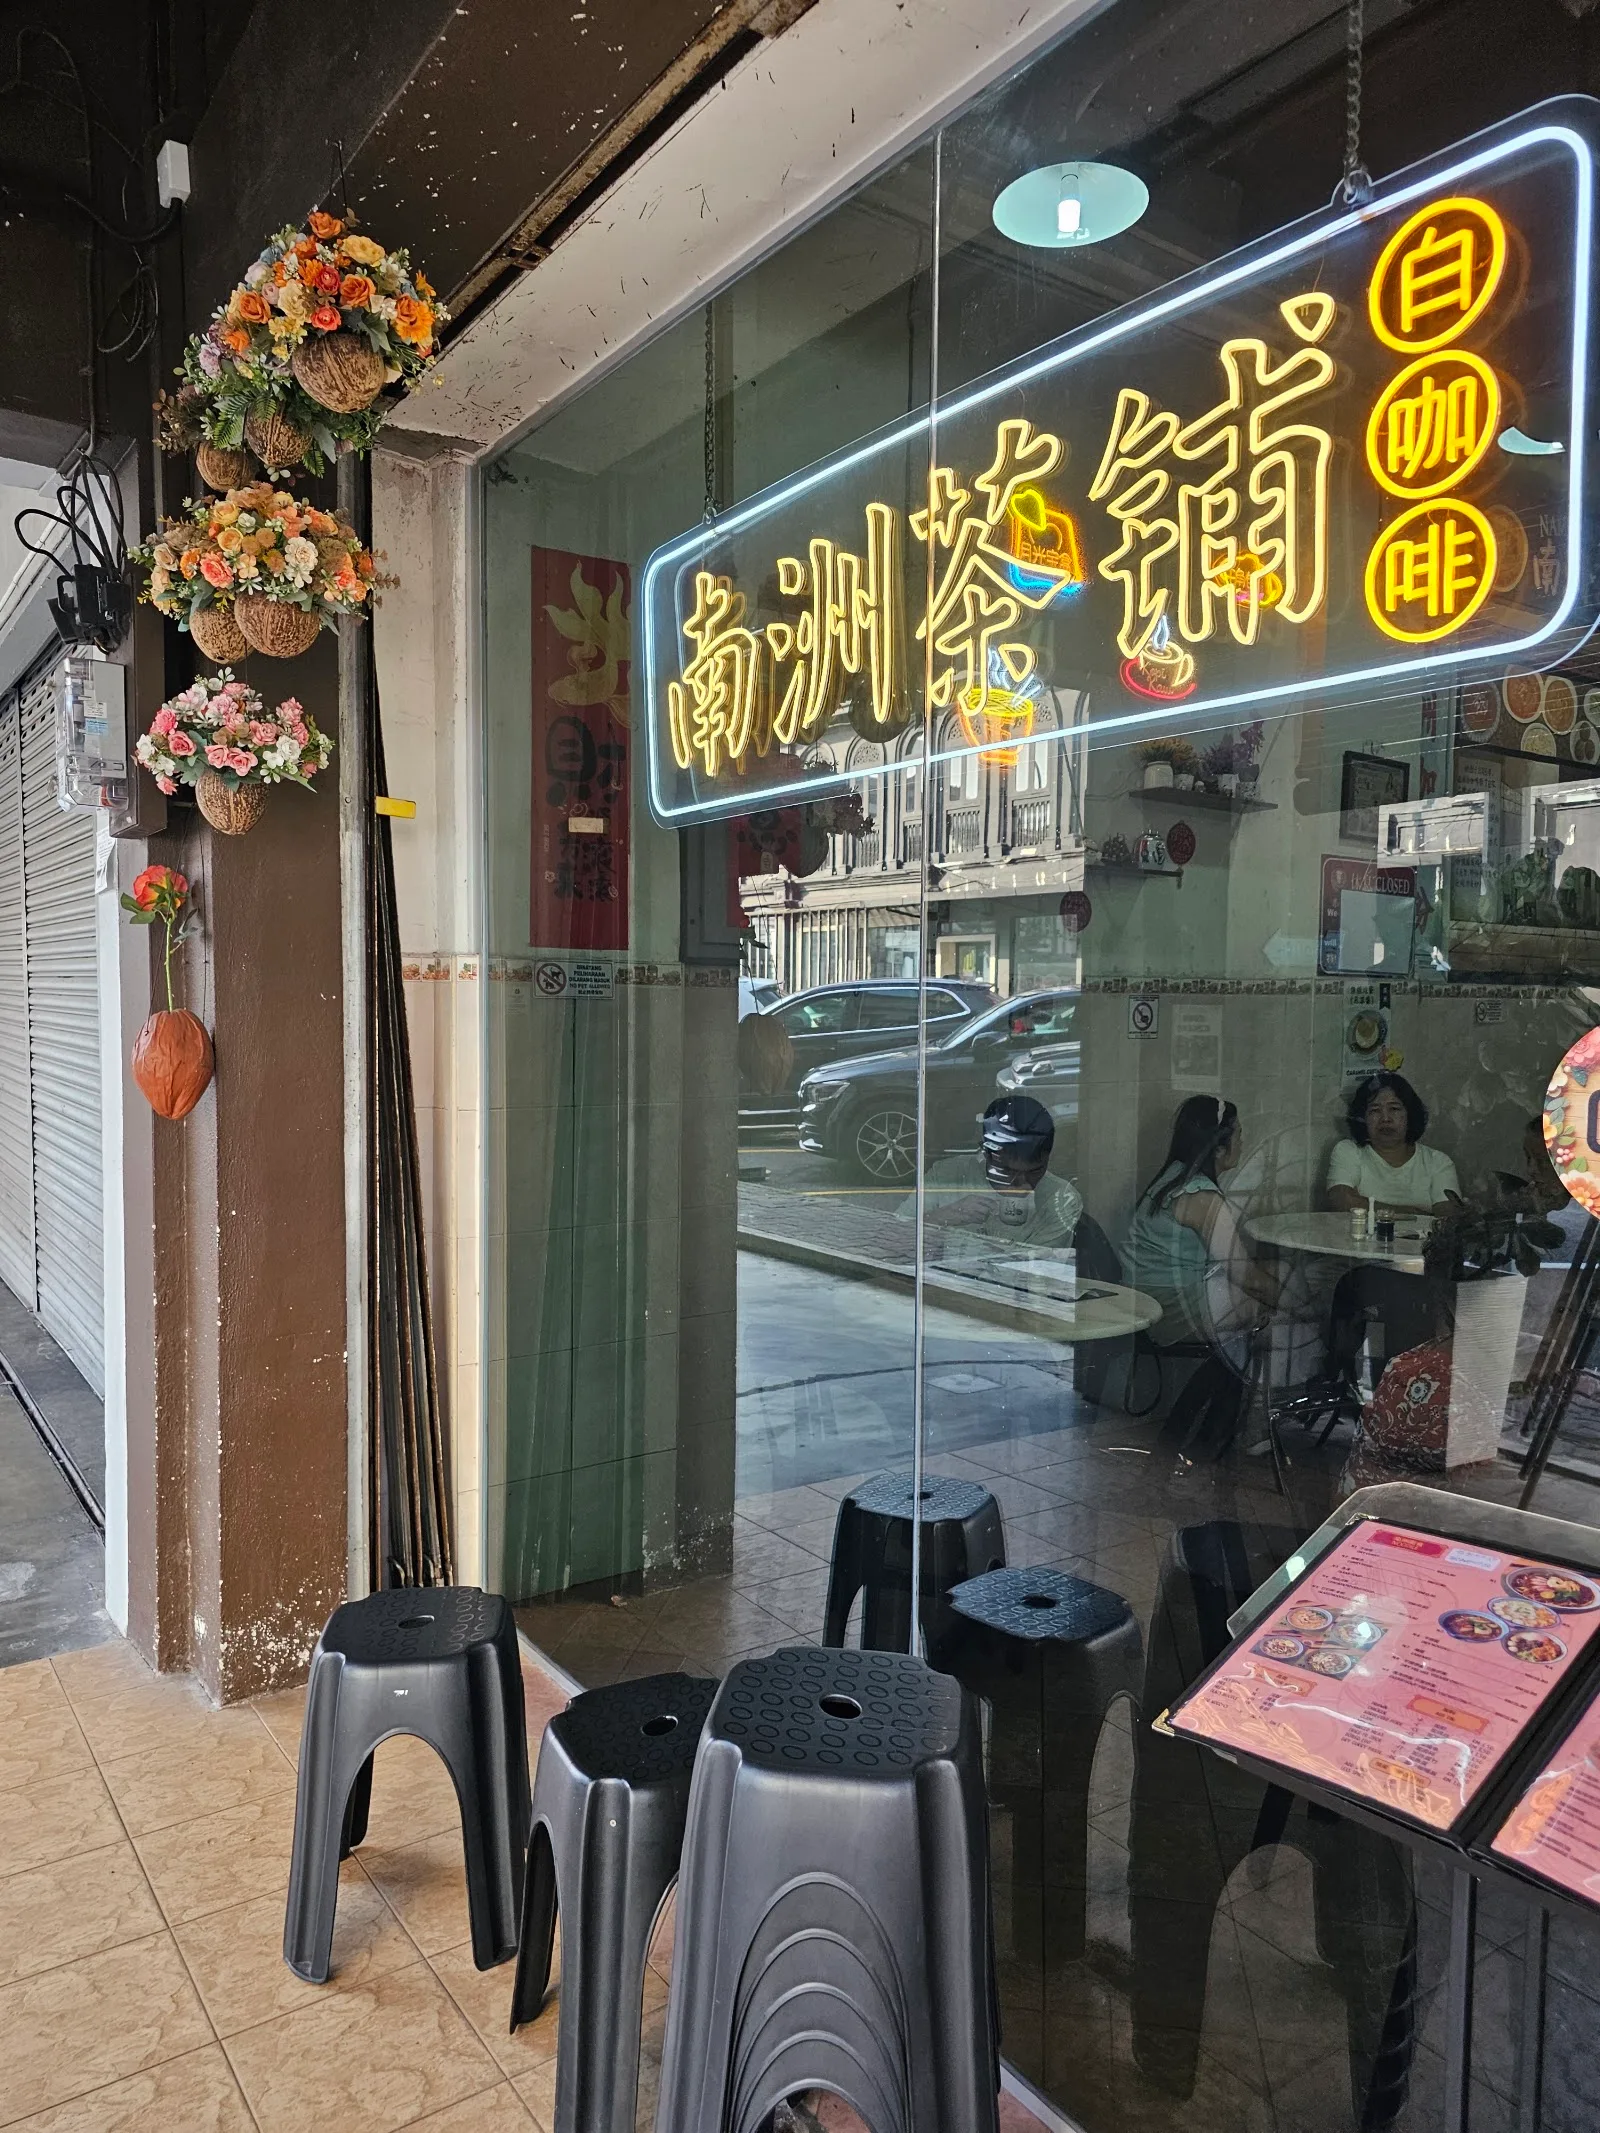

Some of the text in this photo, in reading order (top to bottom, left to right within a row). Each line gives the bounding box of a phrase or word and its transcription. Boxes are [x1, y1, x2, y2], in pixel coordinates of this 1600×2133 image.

[1386, 226, 1478, 617] 白咖啡
[1376, 876, 1410, 894] CLOSED
